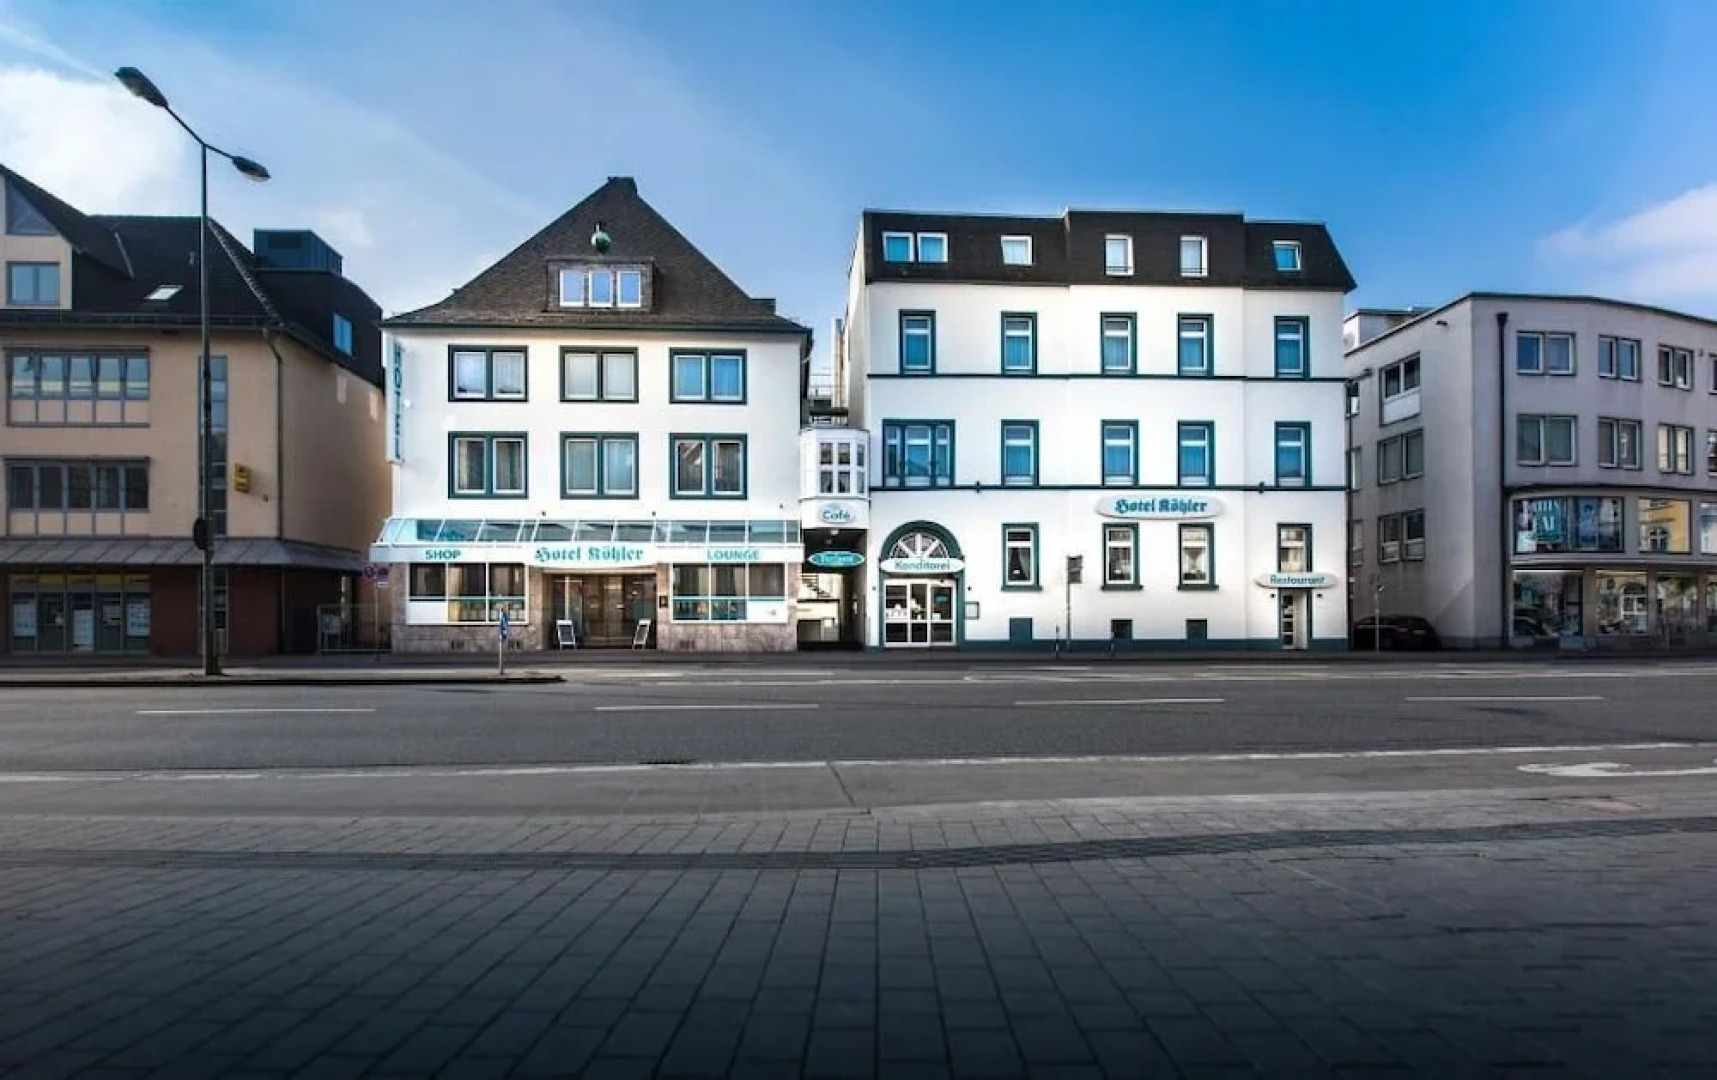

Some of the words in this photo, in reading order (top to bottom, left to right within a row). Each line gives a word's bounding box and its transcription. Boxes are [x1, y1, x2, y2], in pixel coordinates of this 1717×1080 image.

[394, 341, 402, 460] HOTEL
[1115, 499, 1155, 513] Hotel
[1159, 498, 1207, 514] Köhler
[823, 509, 850, 520] Café
[425, 549, 461, 559] SHOP
[536, 547, 580, 562] Hotel
[588, 546, 643, 562] Köhler
[707, 549, 758, 560] LOUNGE
[895, 558, 950, 570] Konditorei
[1270, 574, 1325, 585] Restaurant
